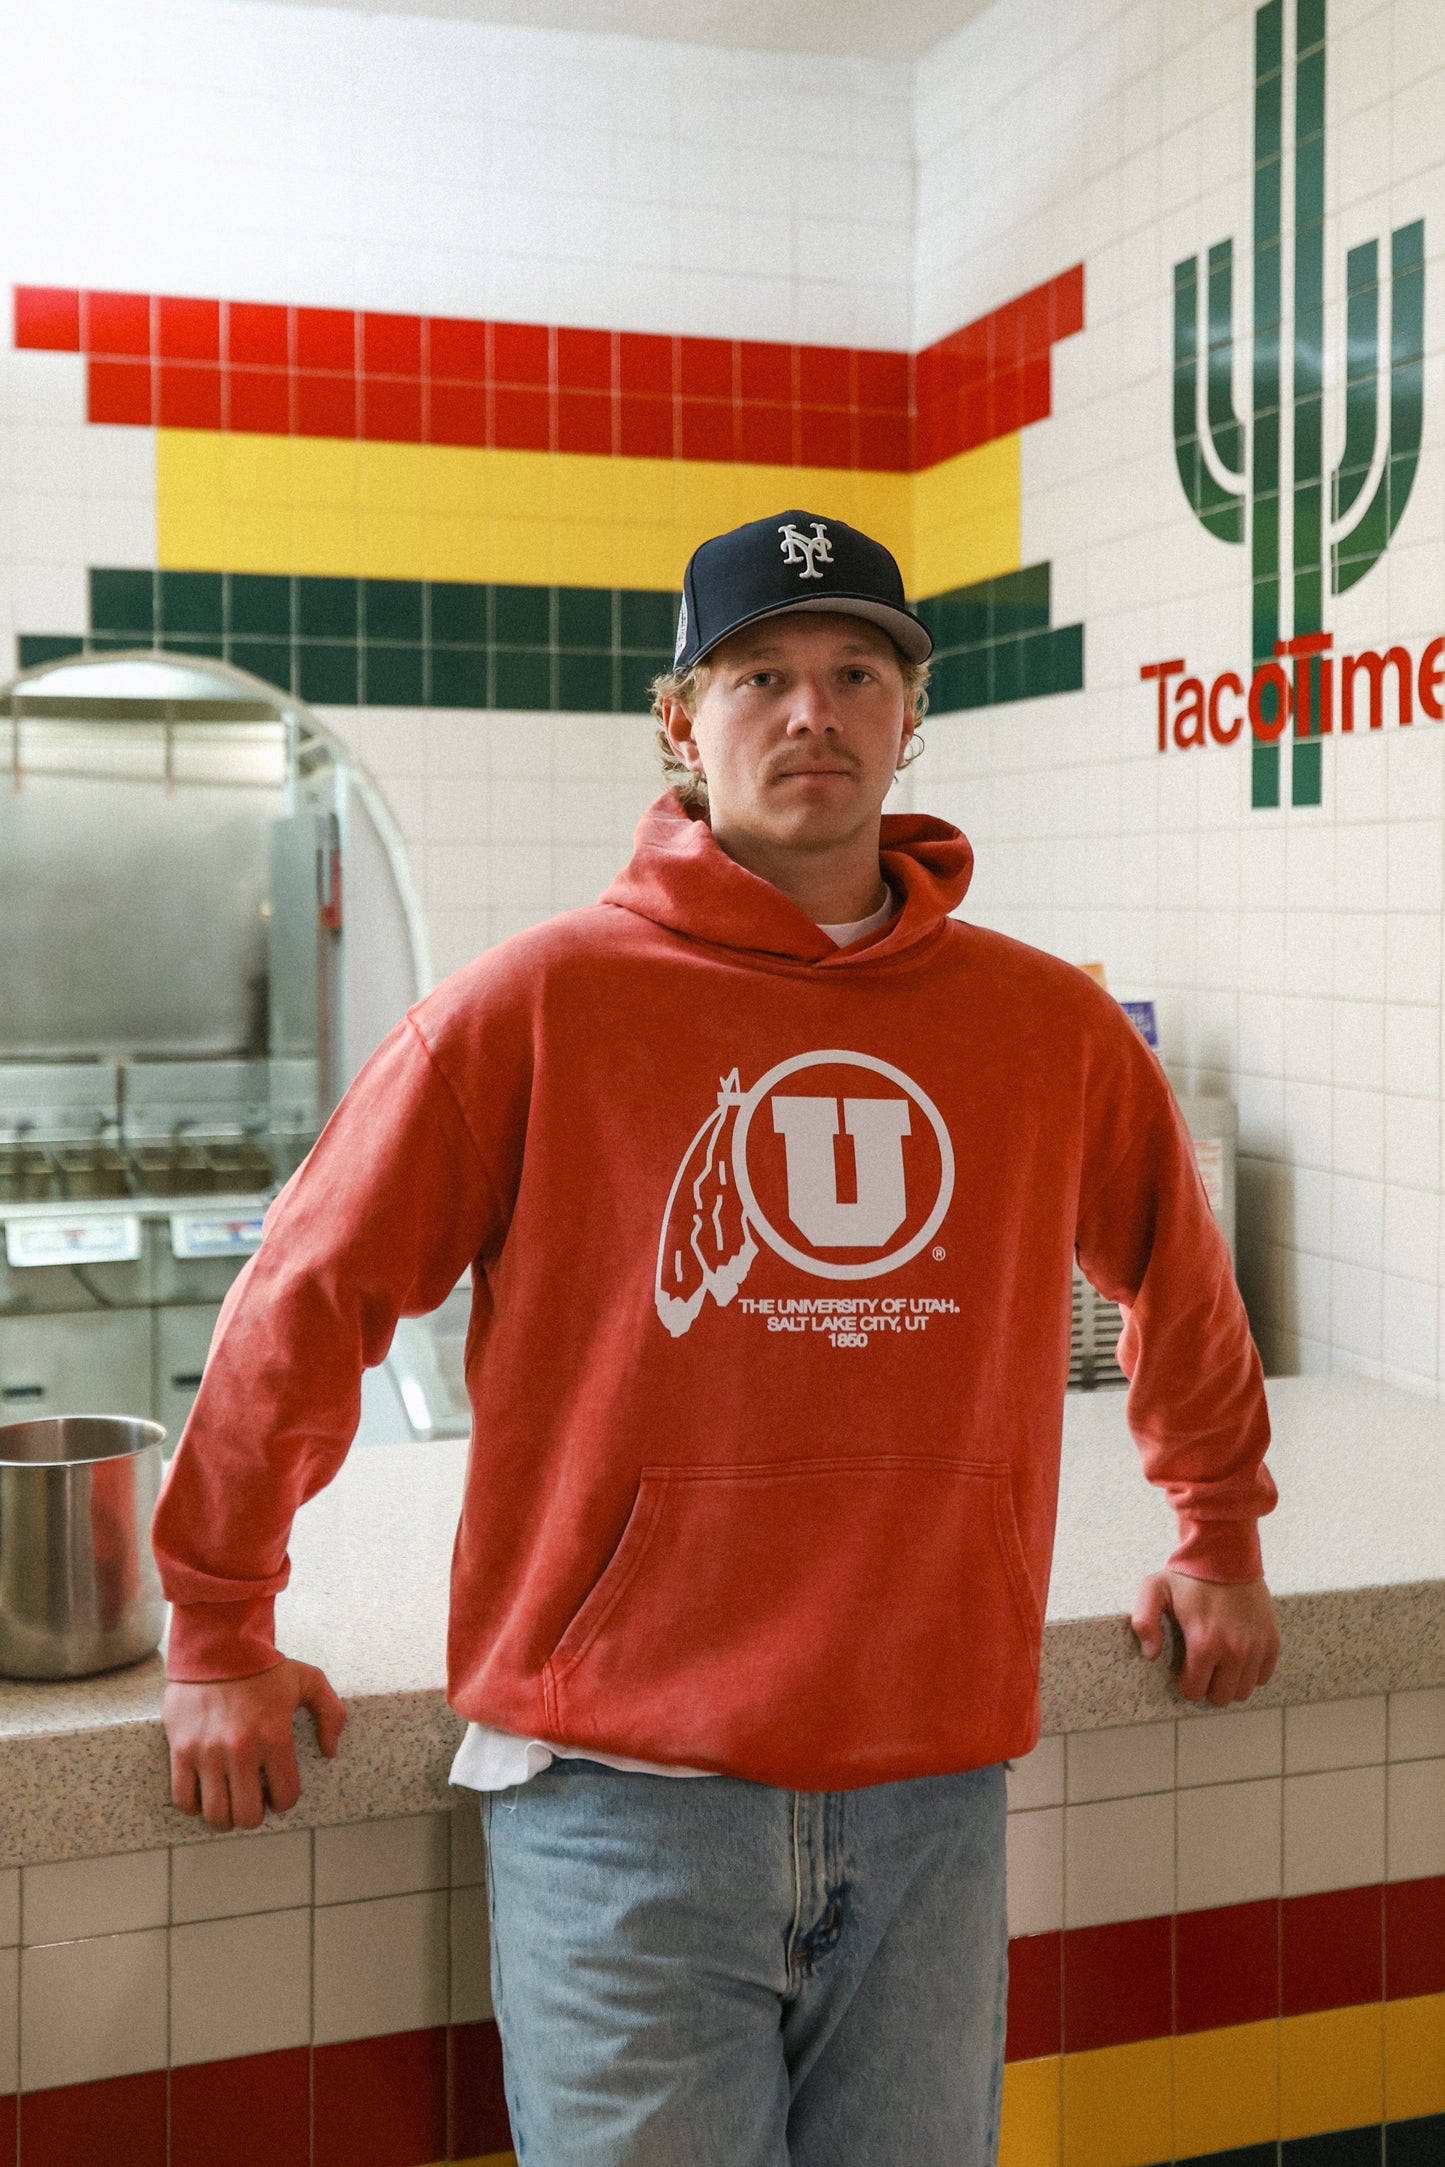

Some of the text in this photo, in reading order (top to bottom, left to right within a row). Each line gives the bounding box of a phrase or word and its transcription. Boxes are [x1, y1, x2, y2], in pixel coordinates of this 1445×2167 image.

[1140, 632, 1445, 753] TacoTime
[771, 1095, 912, 1247] U
[738, 1299, 775, 1314] THE
[777, 1299, 878, 1314] UNIVERSITY
[881, 1299, 907, 1314] OF
[767, 1316, 929, 1333] SALT LAKE CITY, UT
[828, 1333, 868, 1348] 1850
